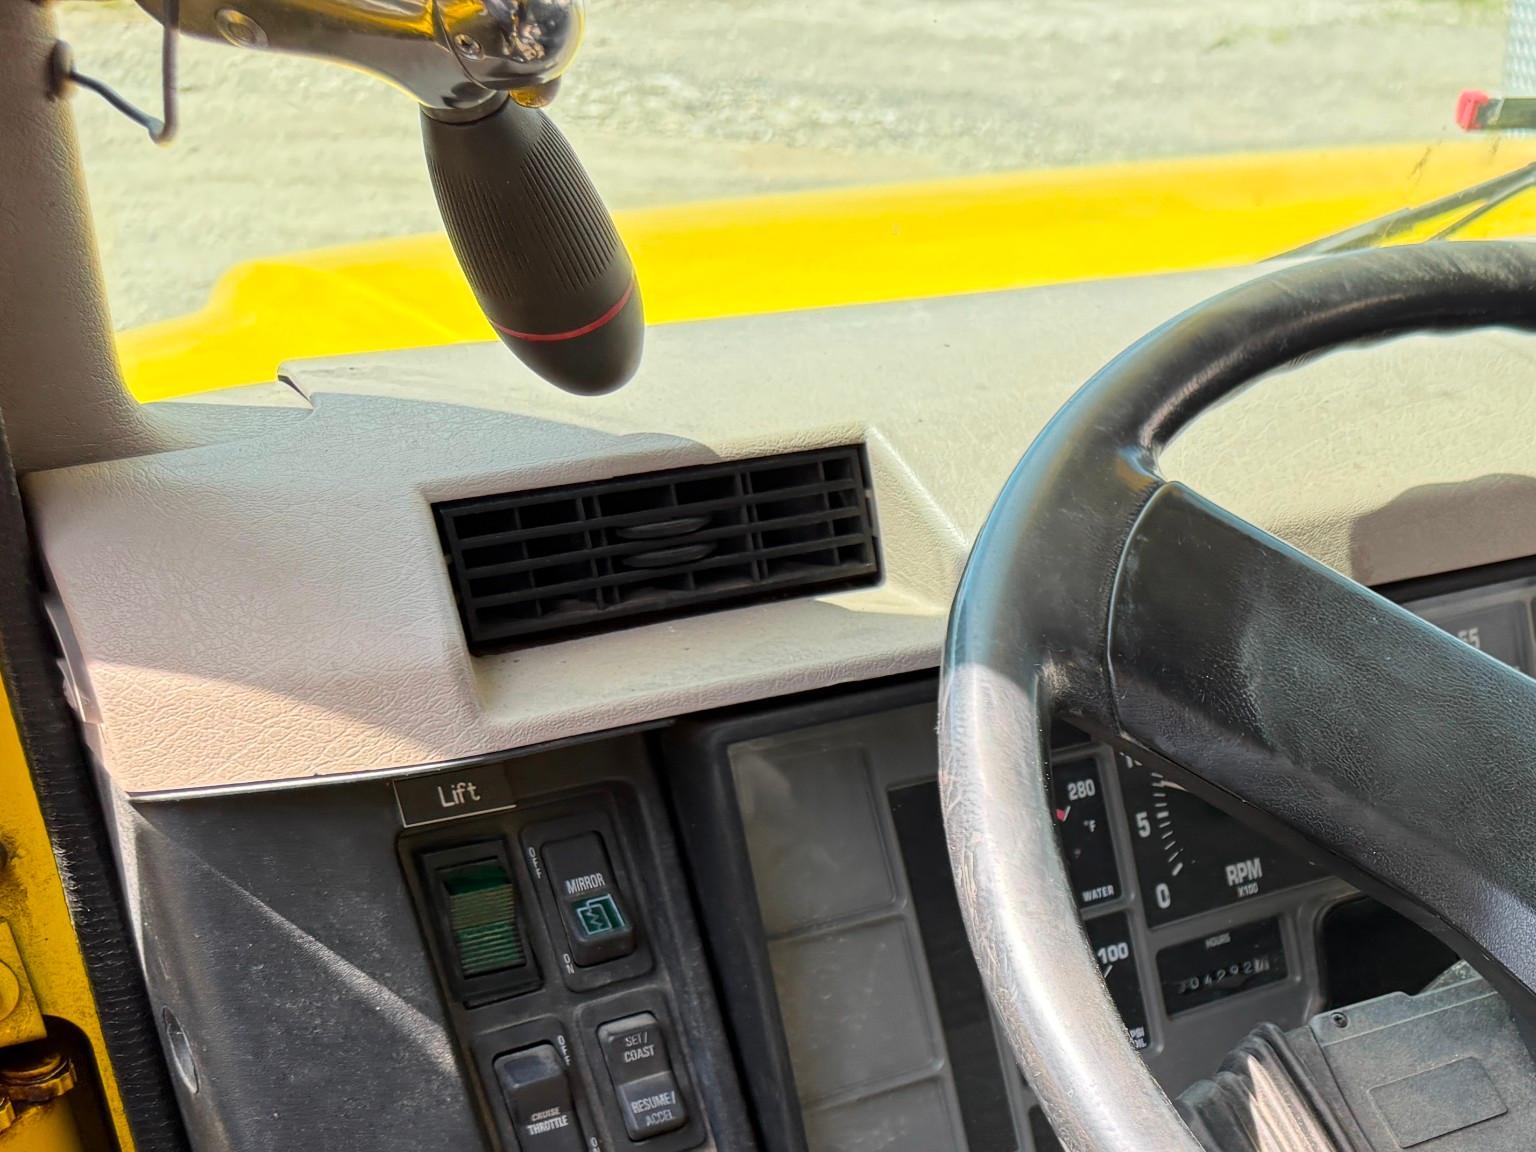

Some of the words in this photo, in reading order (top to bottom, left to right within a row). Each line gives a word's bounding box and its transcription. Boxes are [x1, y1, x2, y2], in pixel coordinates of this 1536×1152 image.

[436, 781, 481, 808] Lift
[1067, 779, 1096, 801] 280
[1135, 811, 1151, 838] 5
[528, 847, 543, 879] OFF
[1225, 858, 1263, 887] RPM
[565, 873, 606, 895] MIRROR
[1082, 885, 1115, 902] WATER
[1155, 883, 1171, 909] 0
[563, 953, 575, 975] ON
[1097, 942, 1130, 965] 100
[557, 1035, 571, 1066] OFF
[624, 1045, 655, 1063] COAST
[631, 1091, 677, 1114] RESUME/
[527, 1115, 569, 1136] THROTTLE
[530, 1107, 561, 1122] CRUISE
[646, 1112, 675, 1127] ACCEL
